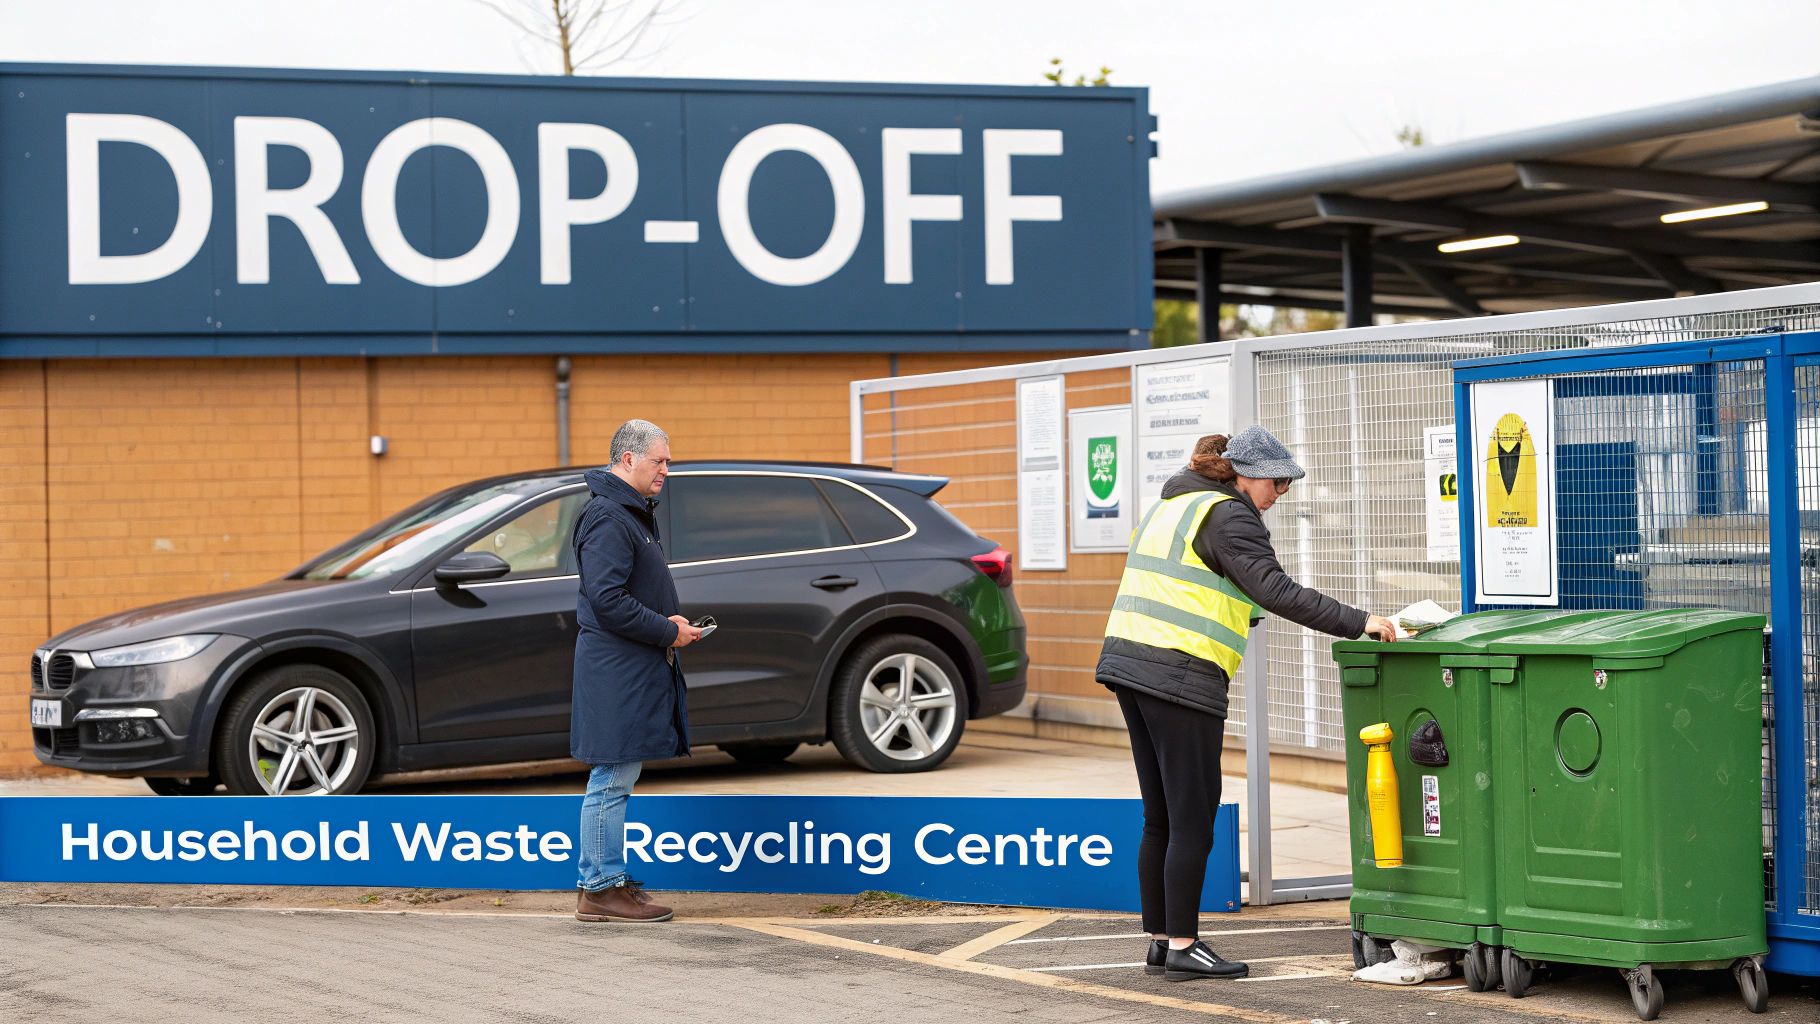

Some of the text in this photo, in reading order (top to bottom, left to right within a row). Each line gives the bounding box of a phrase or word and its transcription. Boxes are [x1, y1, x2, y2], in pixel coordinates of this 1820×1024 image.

[65, 112, 1064, 288] DROP-OFF
[61, 820, 1113, 875] Household Waste Recycling Centre
